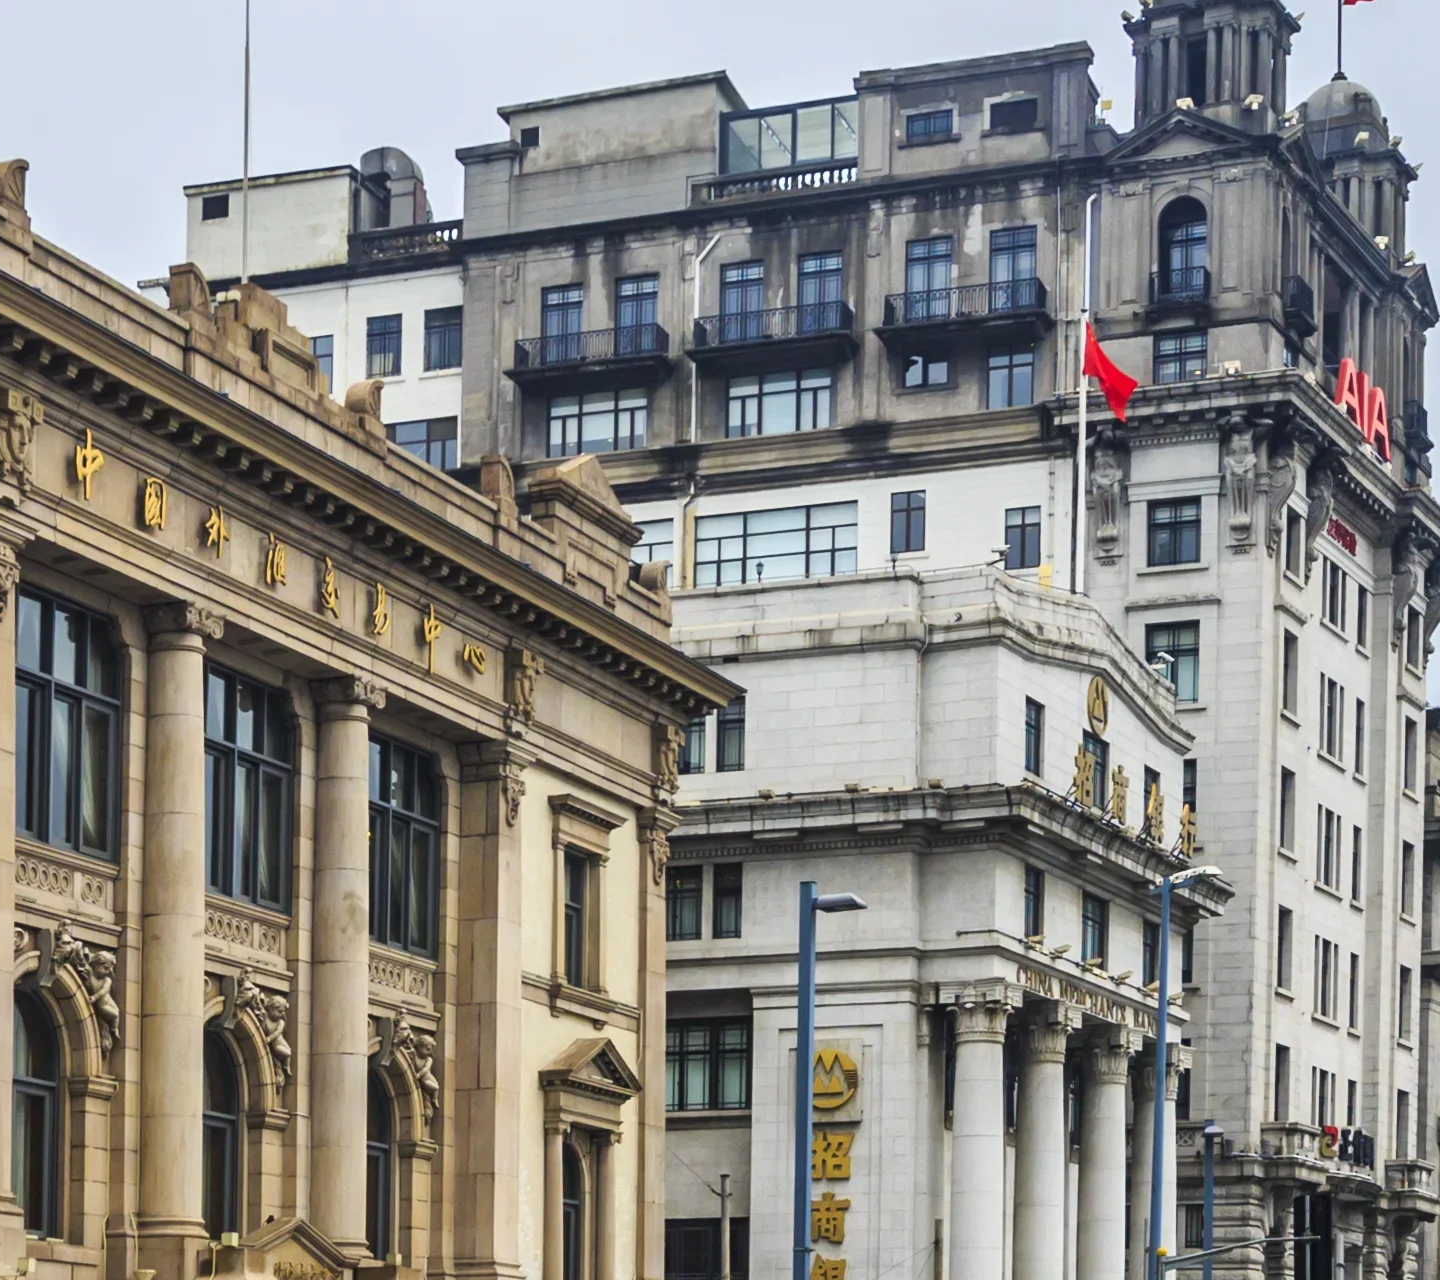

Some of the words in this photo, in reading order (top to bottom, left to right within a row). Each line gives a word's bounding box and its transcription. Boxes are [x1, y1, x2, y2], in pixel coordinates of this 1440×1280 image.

[1334, 357, 1391, 462] AIA
[1016, 964, 1054, 998] CHINA
[1060, 979, 1126, 1023] MERCHANTS
